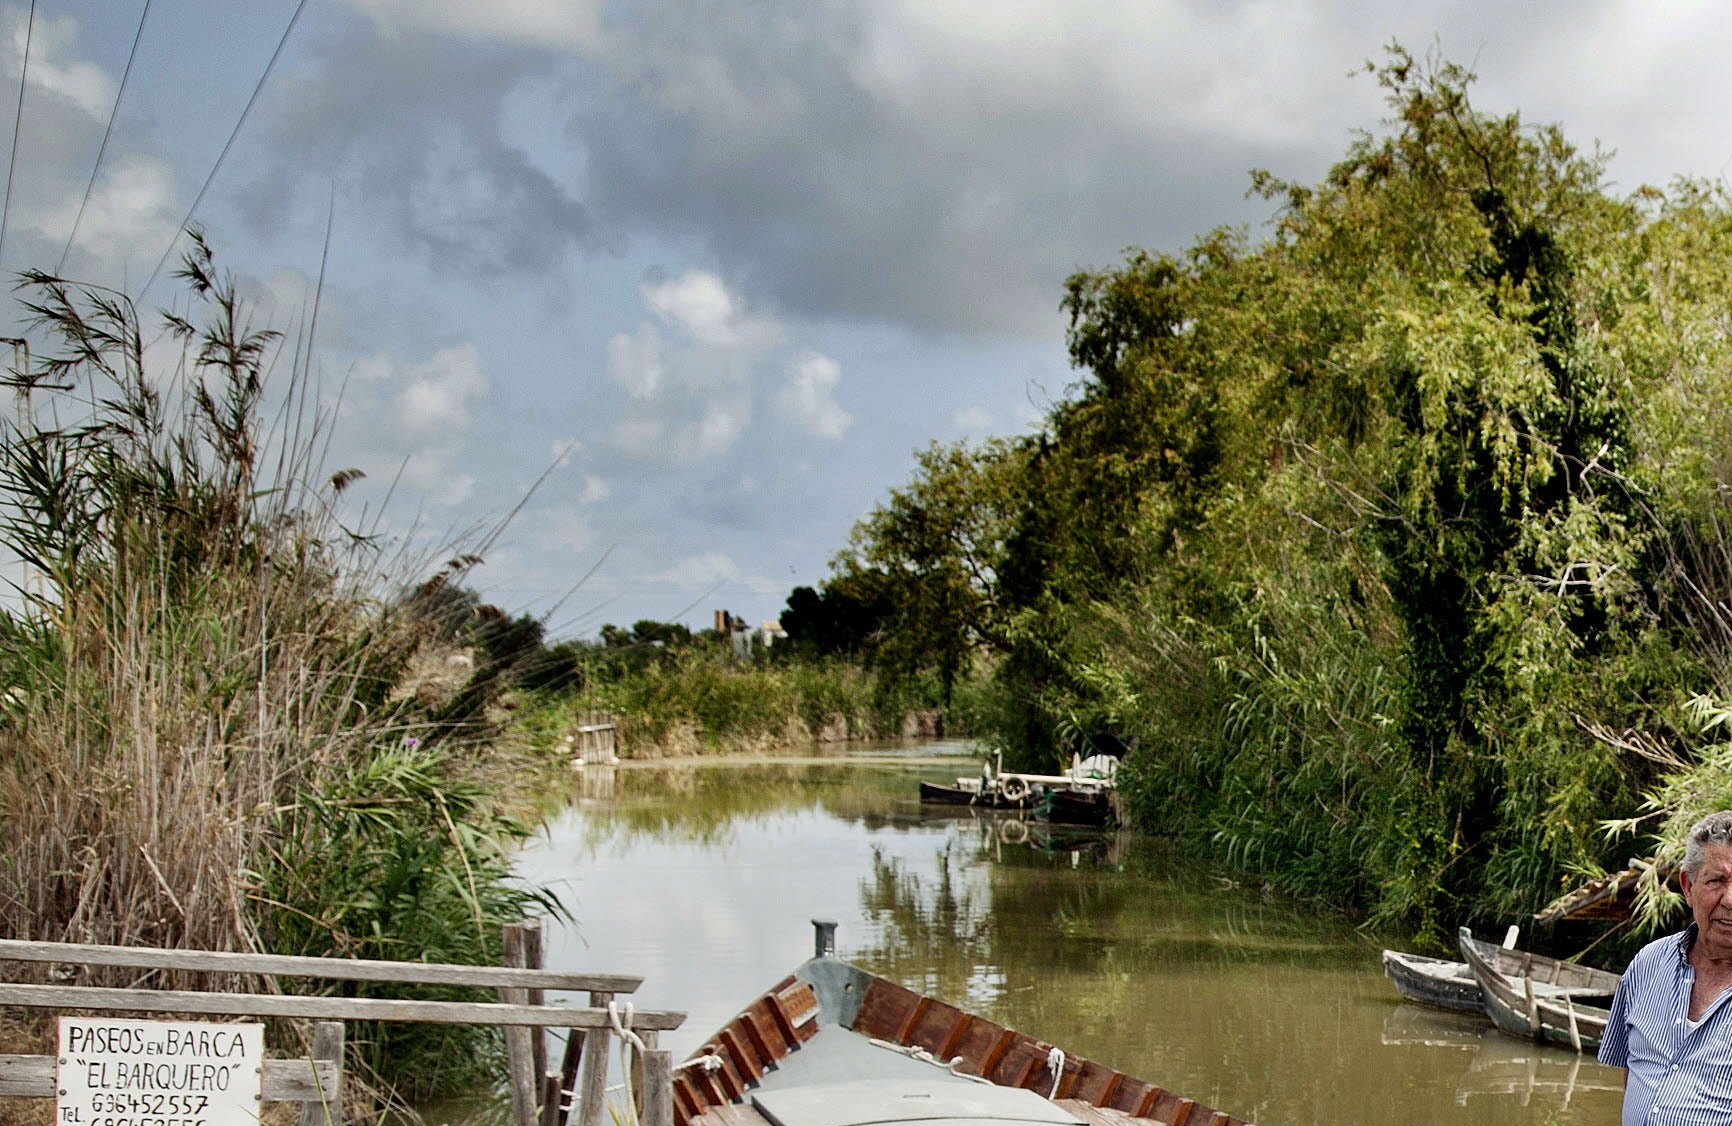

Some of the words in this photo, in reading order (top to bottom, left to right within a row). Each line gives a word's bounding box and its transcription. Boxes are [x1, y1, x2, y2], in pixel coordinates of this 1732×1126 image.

[69, 1026, 144, 1055] PASEOS
[146, 1041, 164, 1055] EN
[166, 1029, 245, 1058] BARCA
[92, 1093, 209, 1115] 696452557
